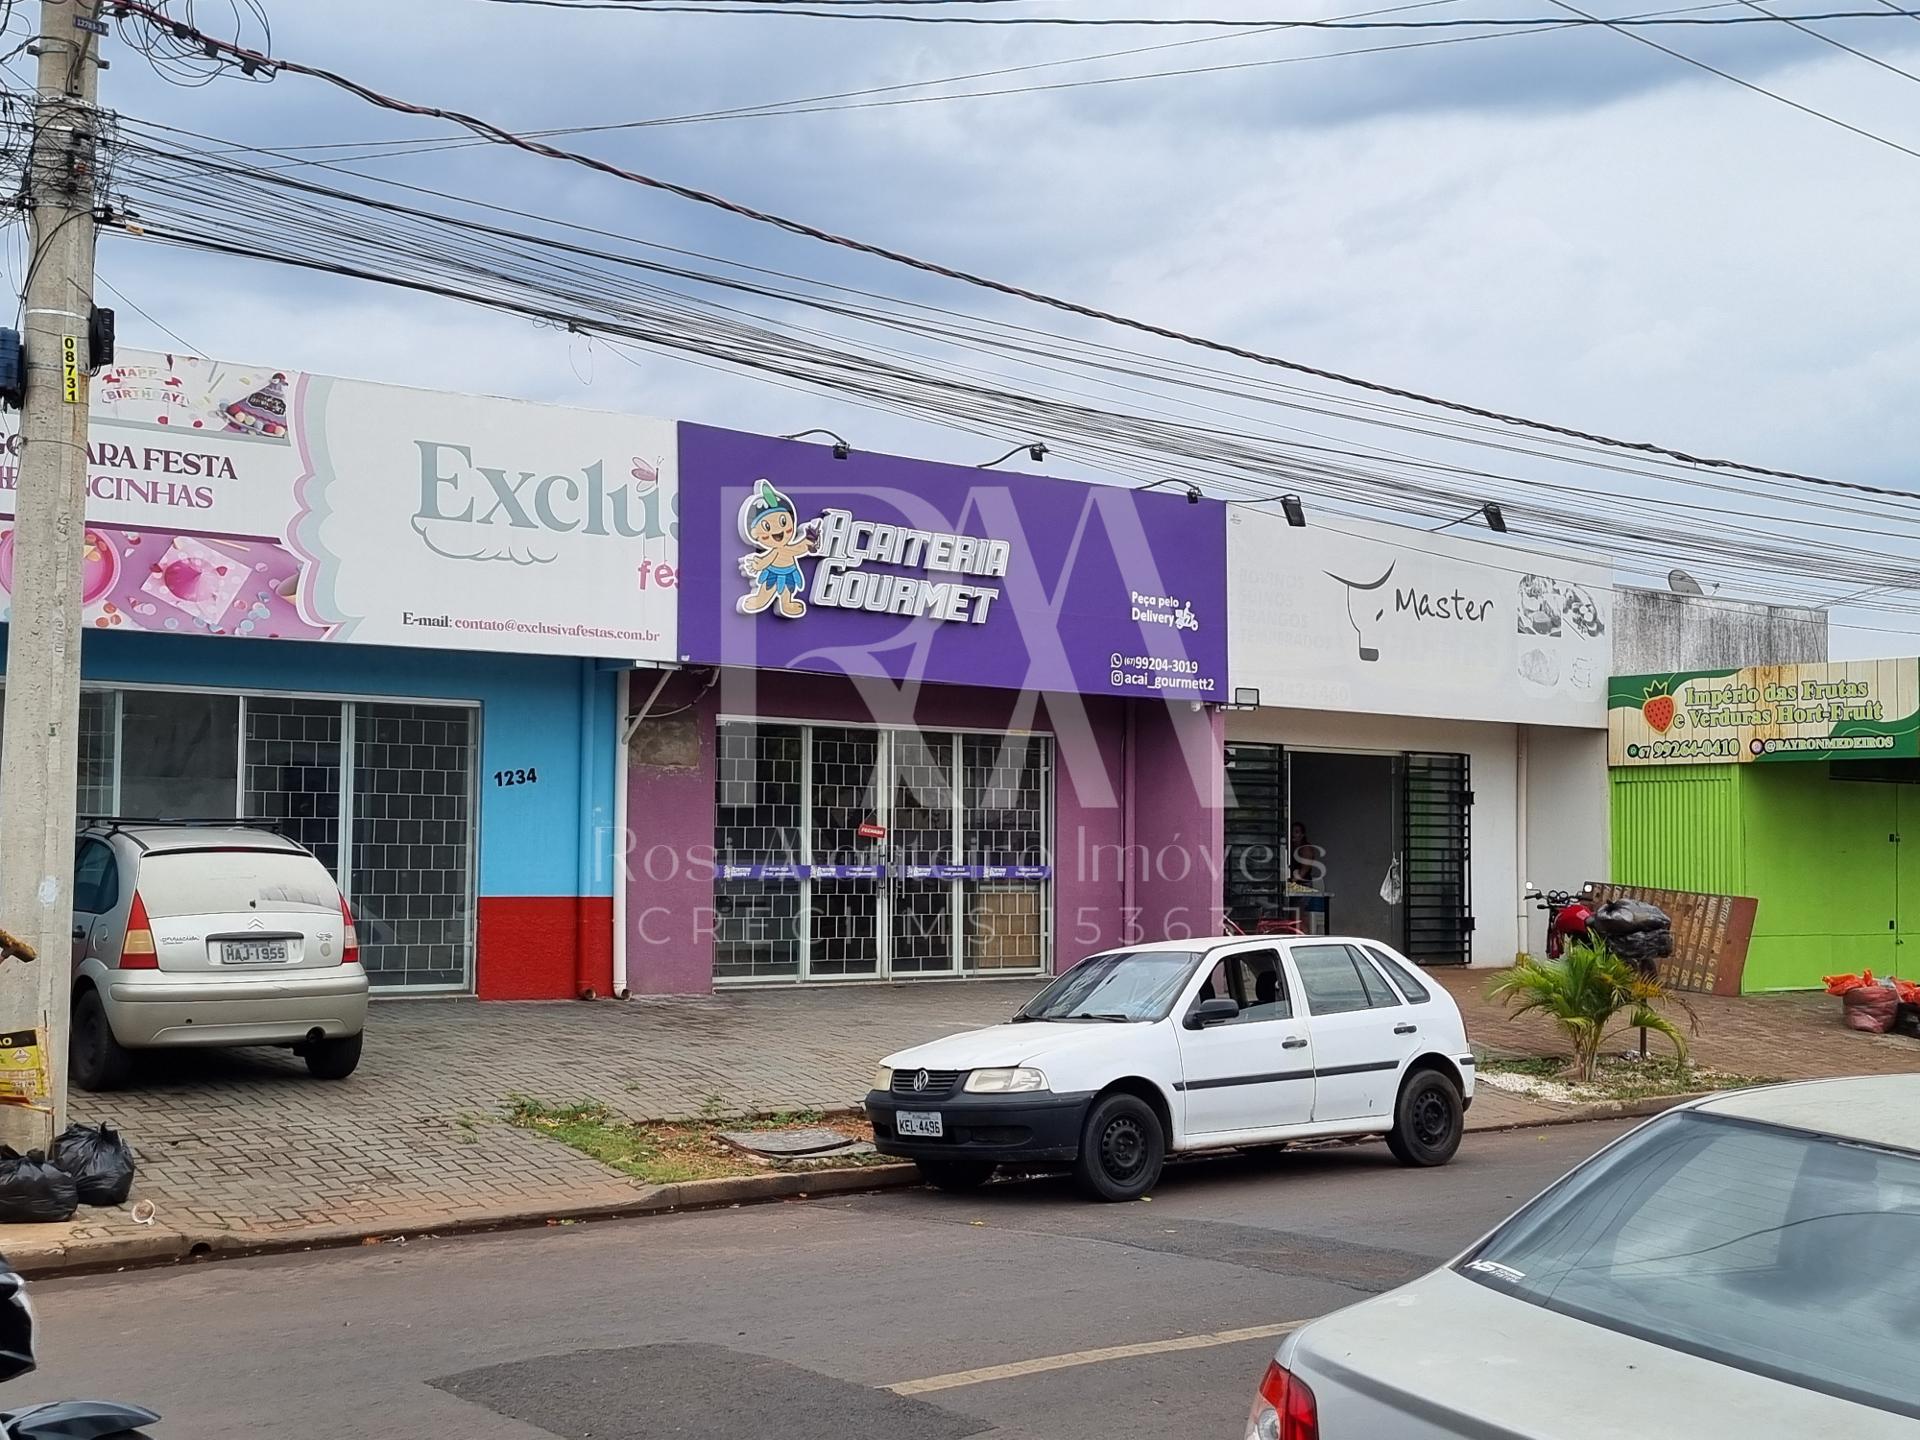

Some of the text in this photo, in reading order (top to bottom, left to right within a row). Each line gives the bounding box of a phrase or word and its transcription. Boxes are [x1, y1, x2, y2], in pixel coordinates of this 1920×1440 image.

[64, 337, 76, 401] 08731
[143, 447, 239, 480] FESTA
[810, 556, 1000, 625] GOURMET
[1131, 591, 1180, 608] Peça pelo
[1396, 587, 1494, 622] Master
[402, 611, 660, 642] E-mail: contato@exclusivafestas.com.br
[1131, 607, 1175, 627] Delivery
[1124, 672, 1215, 691] acai_gourmett2
[1685, 679, 1869, 709] Império das Frutas
[1673, 700, 1884, 729] e Verduras Hort-Fruit
[1638, 745, 1651, 759] 67
[1653, 738, 1740, 758] 99264-0410
[494, 767, 537, 787] 1234
